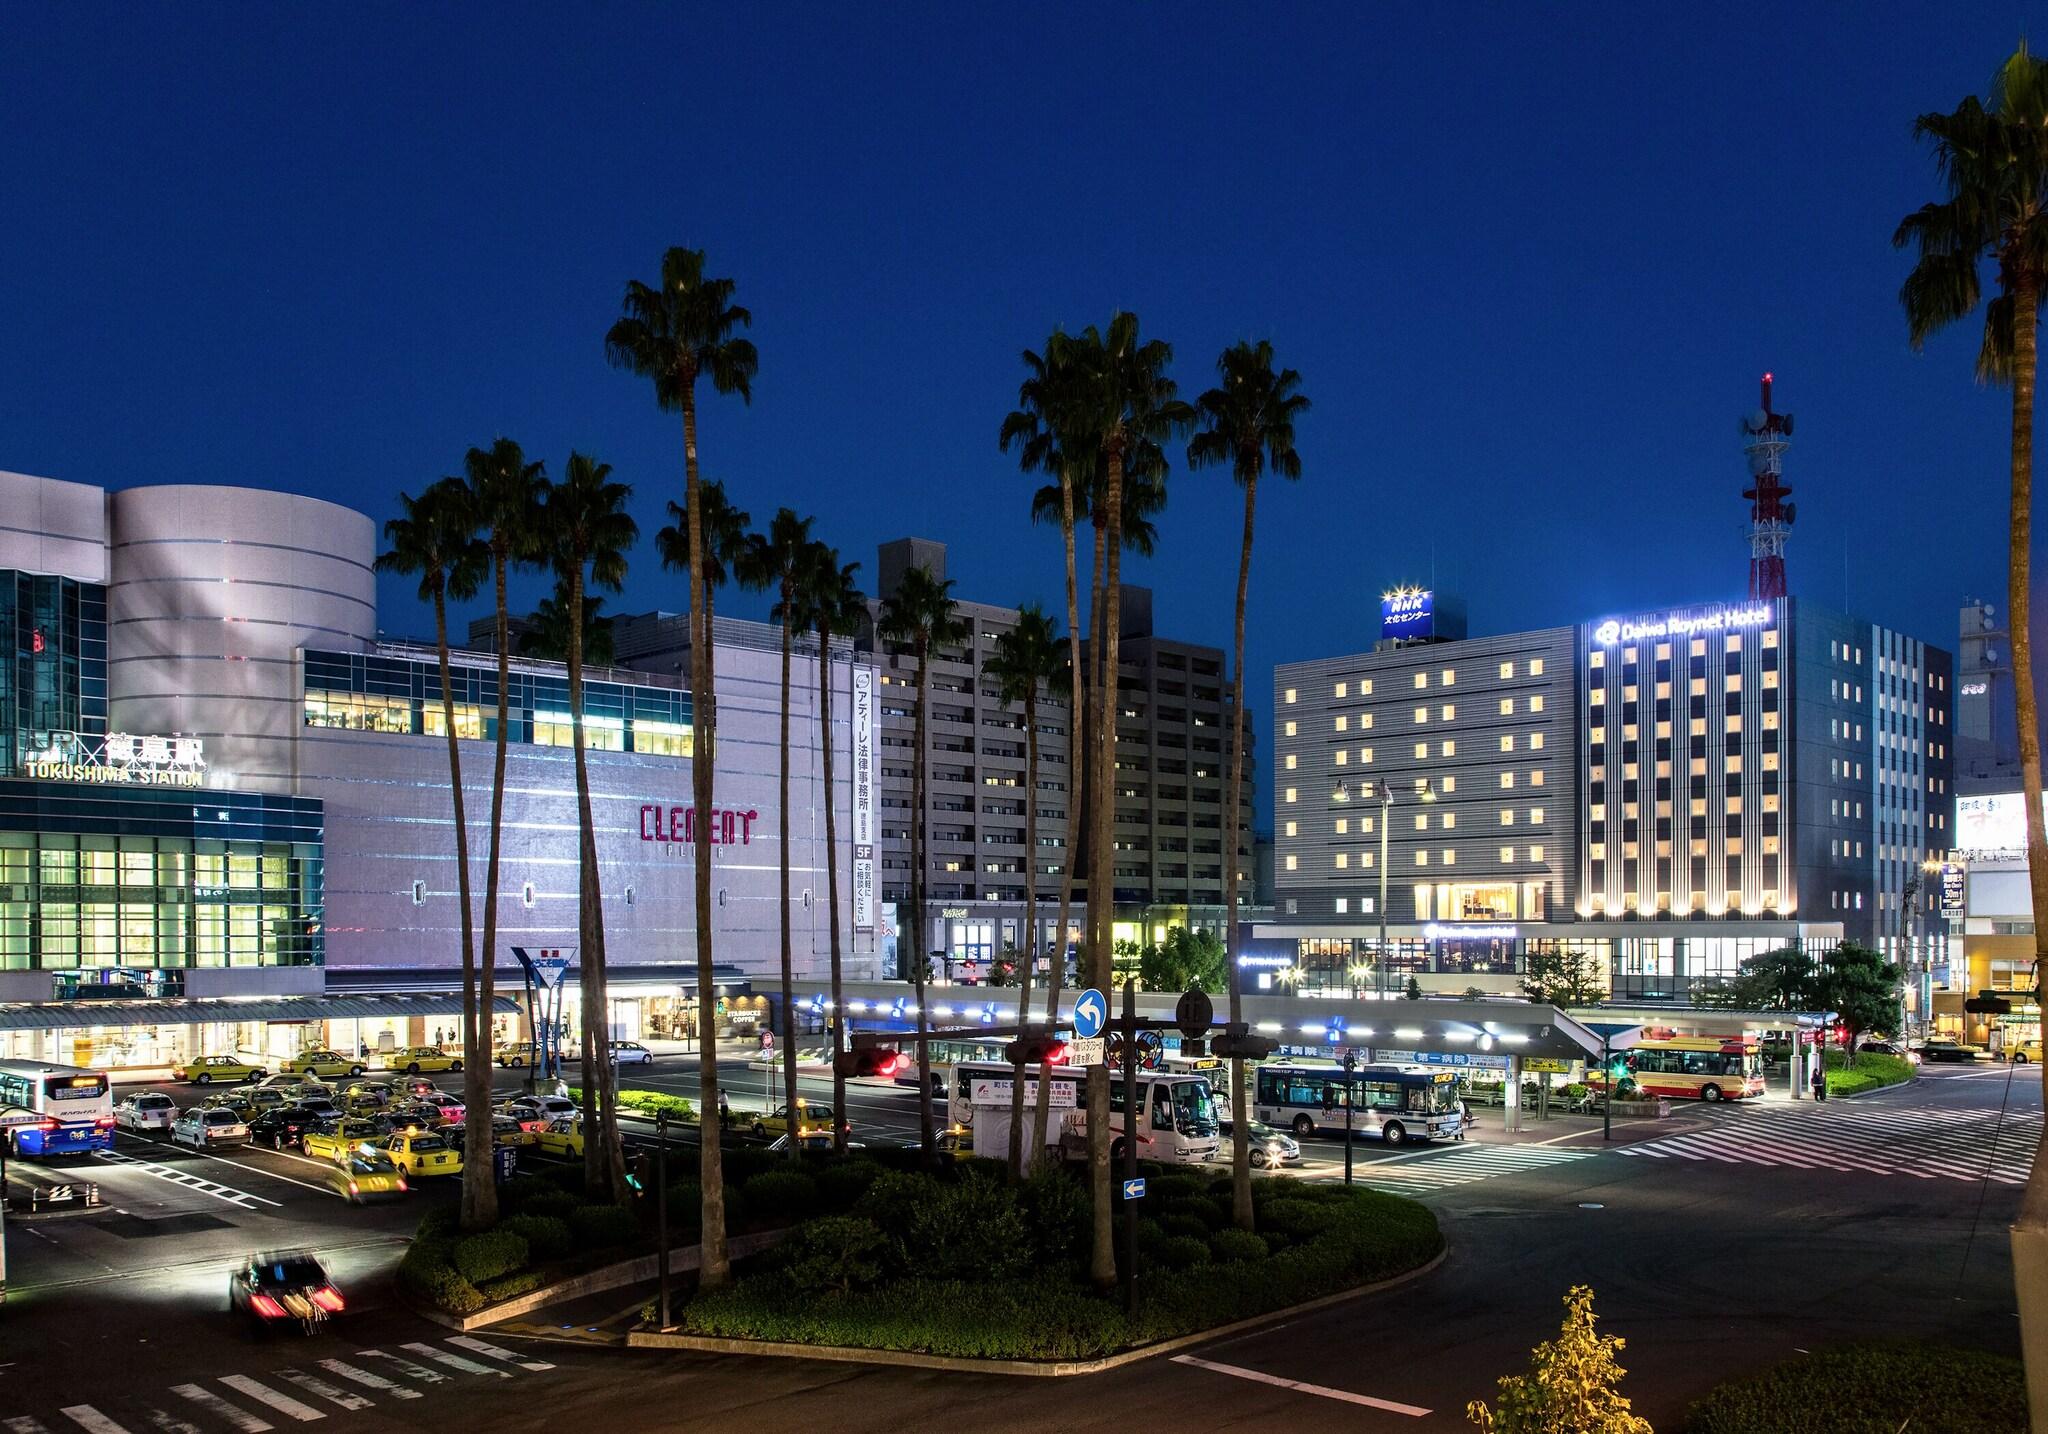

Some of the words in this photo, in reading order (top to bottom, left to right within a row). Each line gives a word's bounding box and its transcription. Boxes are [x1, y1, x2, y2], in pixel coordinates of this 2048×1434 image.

[1391, 597, 1423, 613] NHK
[1384, 610, 1431, 625] 文化センター
[1622, 622, 1666, 641] Daiwa
[1668, 615, 1723, 636] Roynet
[1725, 605, 1769, 627] Hotel
[857, 690, 869, 811] アディーレ法律事務所
[26, 761, 129, 784] TOKUSHIMA
[139, 767, 203, 788] STATION
[667, 844, 725, 859] PLA
[857, 847, 871, 858] 5F
[857, 863, 865, 922] ご相談ください
[732, 1015, 756, 1024] COFFEE
[1417, 1053, 1466, 1065] 第一病院
